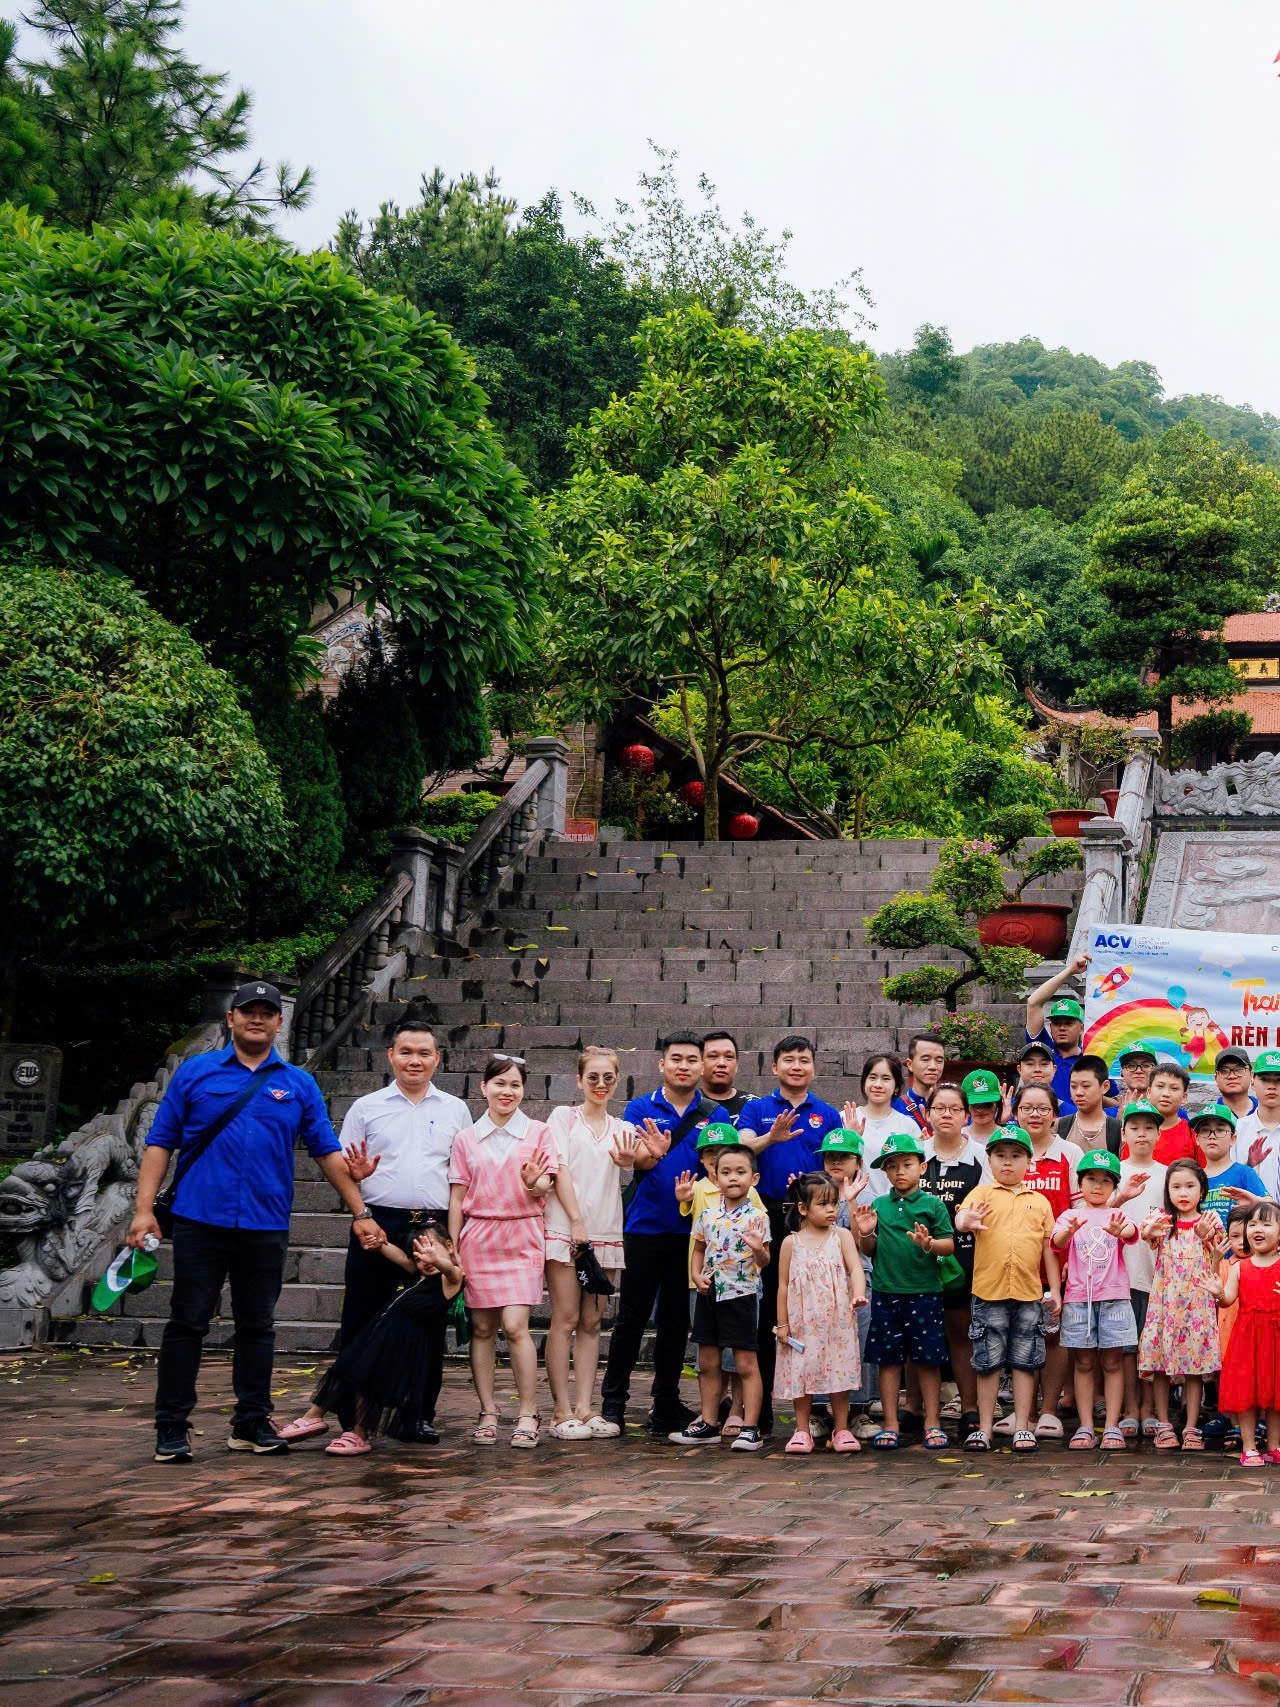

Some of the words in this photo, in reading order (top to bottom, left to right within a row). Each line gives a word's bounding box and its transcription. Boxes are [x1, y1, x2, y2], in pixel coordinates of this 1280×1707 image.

[1094, 934, 1133, 949] ACV
[1232, 979, 1280, 1017] Trại
[1231, 1021, 1269, 1047] RÈN
